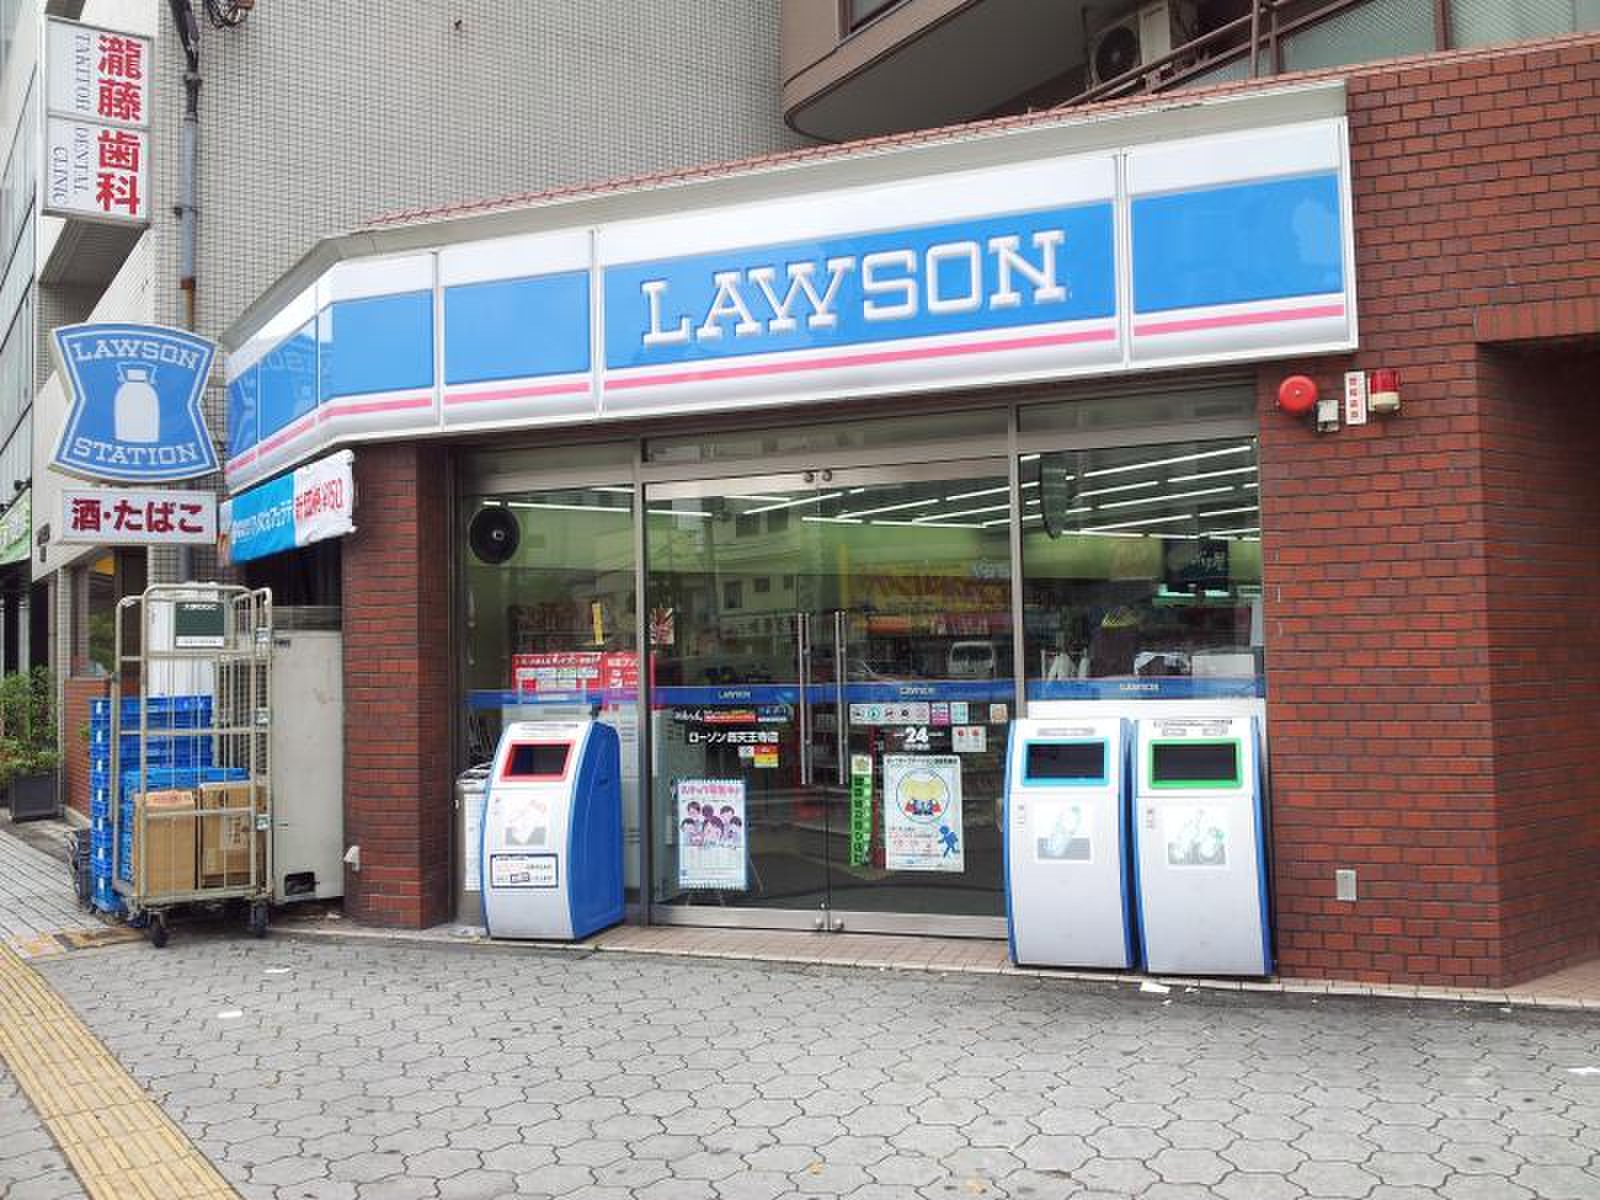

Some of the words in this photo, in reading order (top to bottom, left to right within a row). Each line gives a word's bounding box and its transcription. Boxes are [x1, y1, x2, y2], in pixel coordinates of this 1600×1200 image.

[52, 146, 68, 204] CLINIC
[73, 127, 90, 193] DENTAL
[640, 229, 1067, 346] LAWSON
[71, 338, 200, 369] LAWSON
[73, 437, 198, 465] STATION
[71, 498, 204, 533] 酒・たばこ
[904, 726, 929, 743] 24
